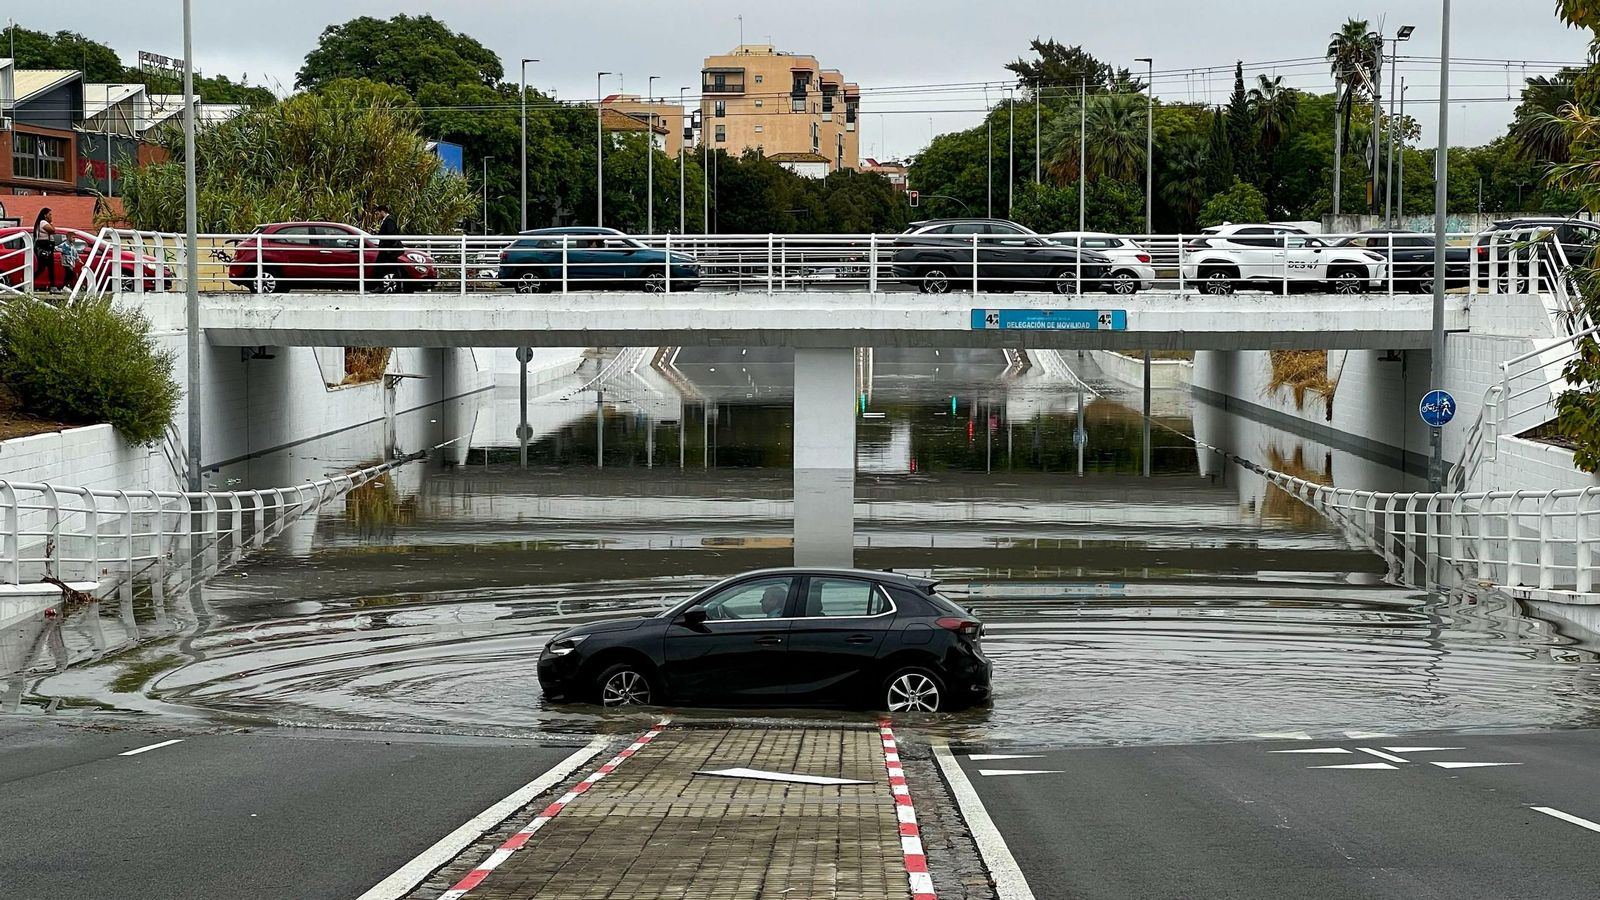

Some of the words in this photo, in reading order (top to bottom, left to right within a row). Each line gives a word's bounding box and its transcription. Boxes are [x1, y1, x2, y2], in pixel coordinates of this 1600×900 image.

[1006, 319, 1046, 329] DELEGACIÓN
[1046, 321, 1056, 329] DE
[1056, 321, 1091, 329] MOVILIDAD
